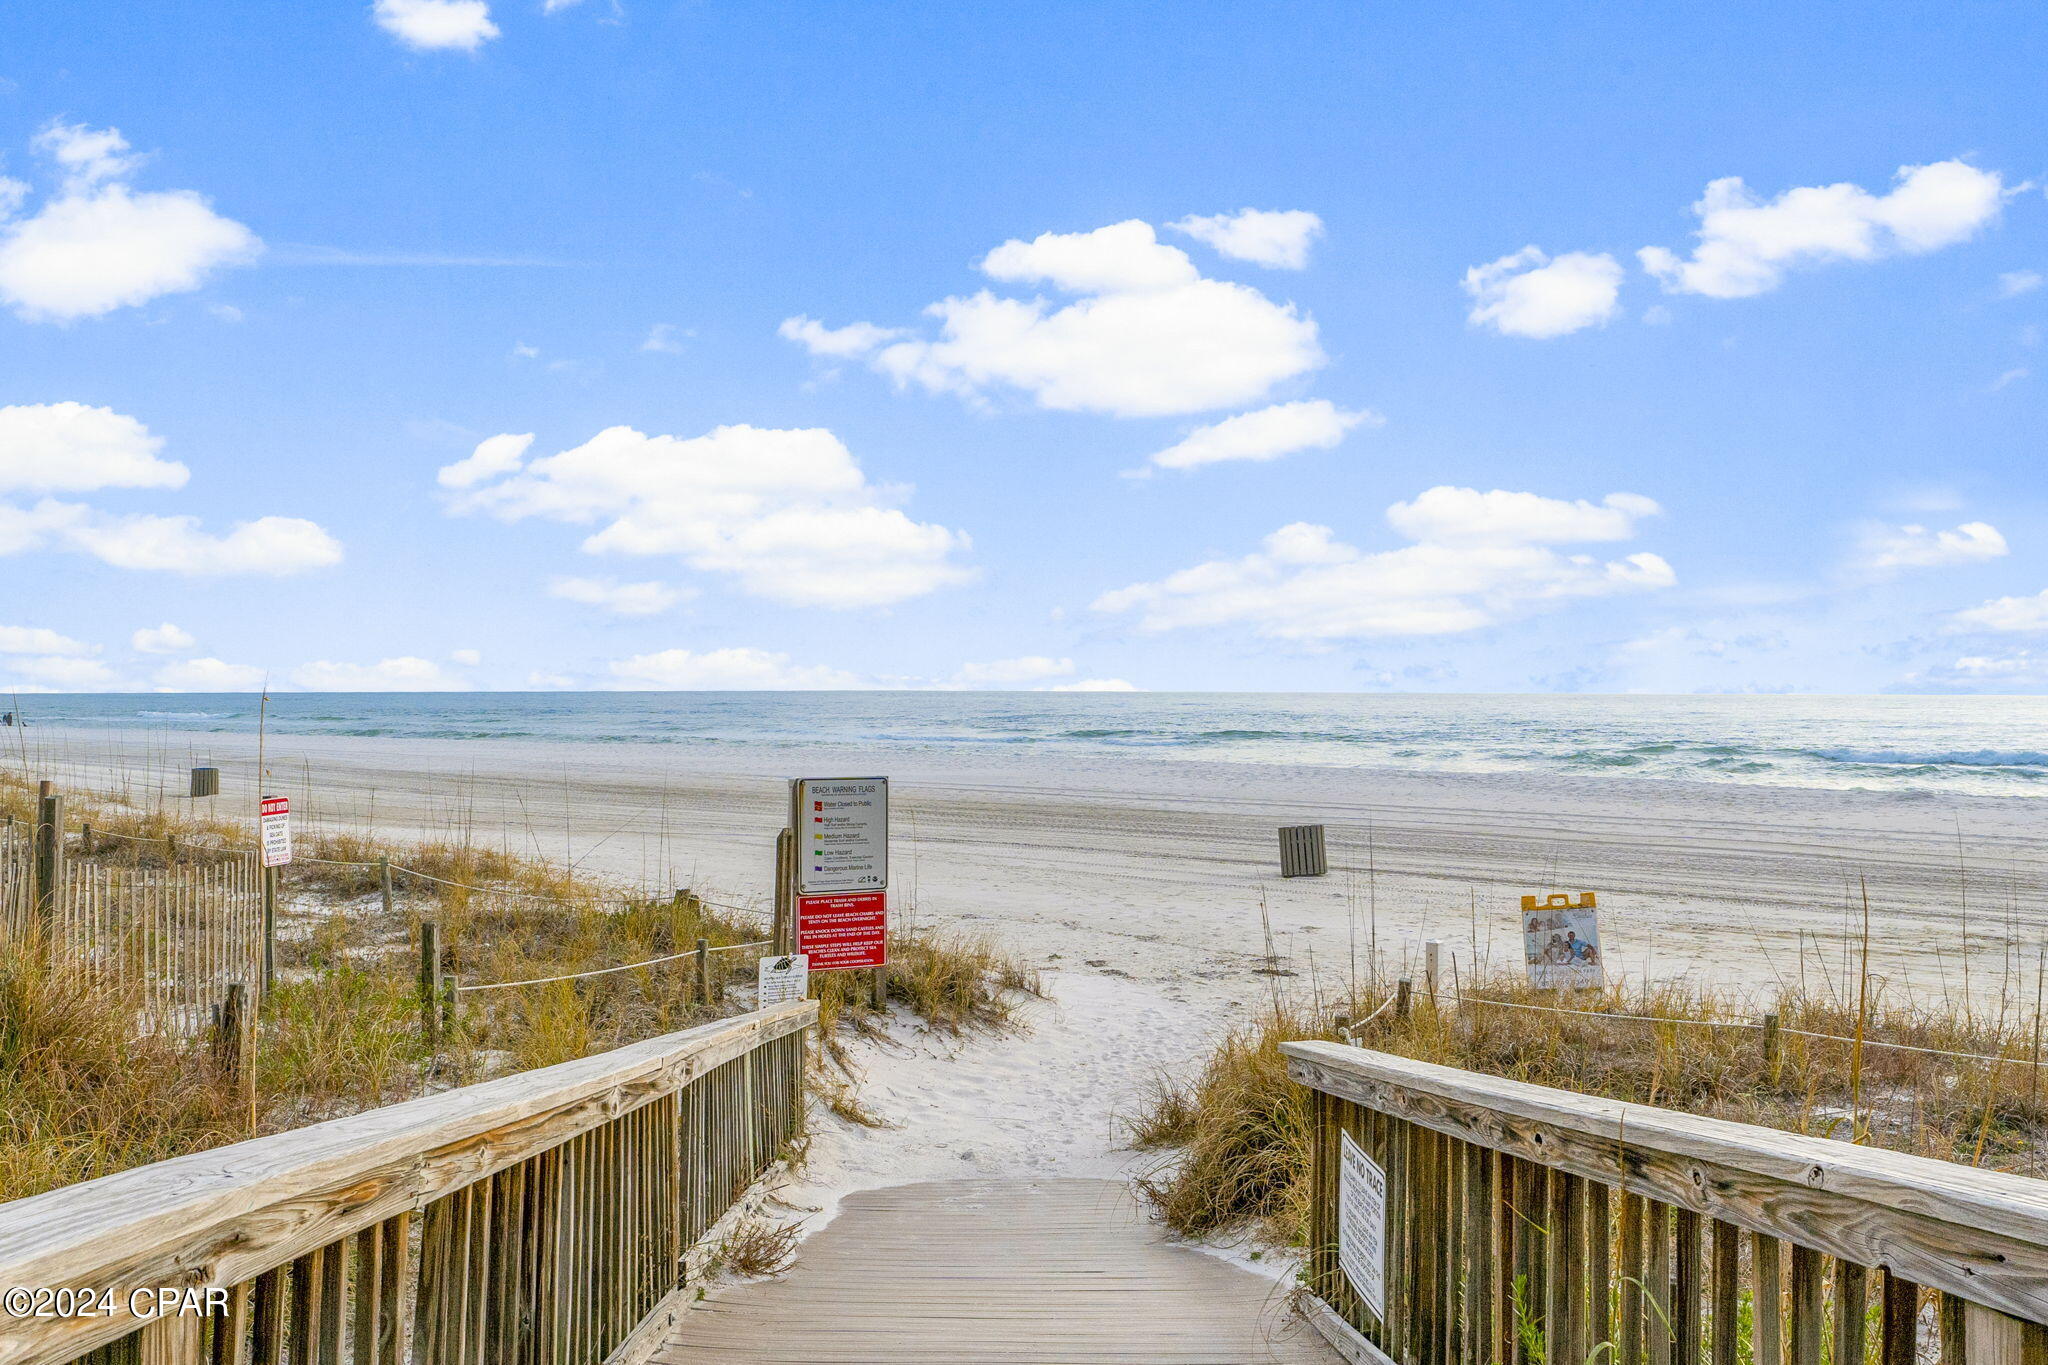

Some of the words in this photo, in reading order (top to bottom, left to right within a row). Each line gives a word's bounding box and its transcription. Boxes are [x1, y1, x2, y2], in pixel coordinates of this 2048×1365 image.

[262, 804, 267, 813] DO
[1344, 1142, 1355, 1169] LEAVE
[1357, 1158, 1365, 1178] NO
[1366, 1168, 1382, 1198] TRACE
